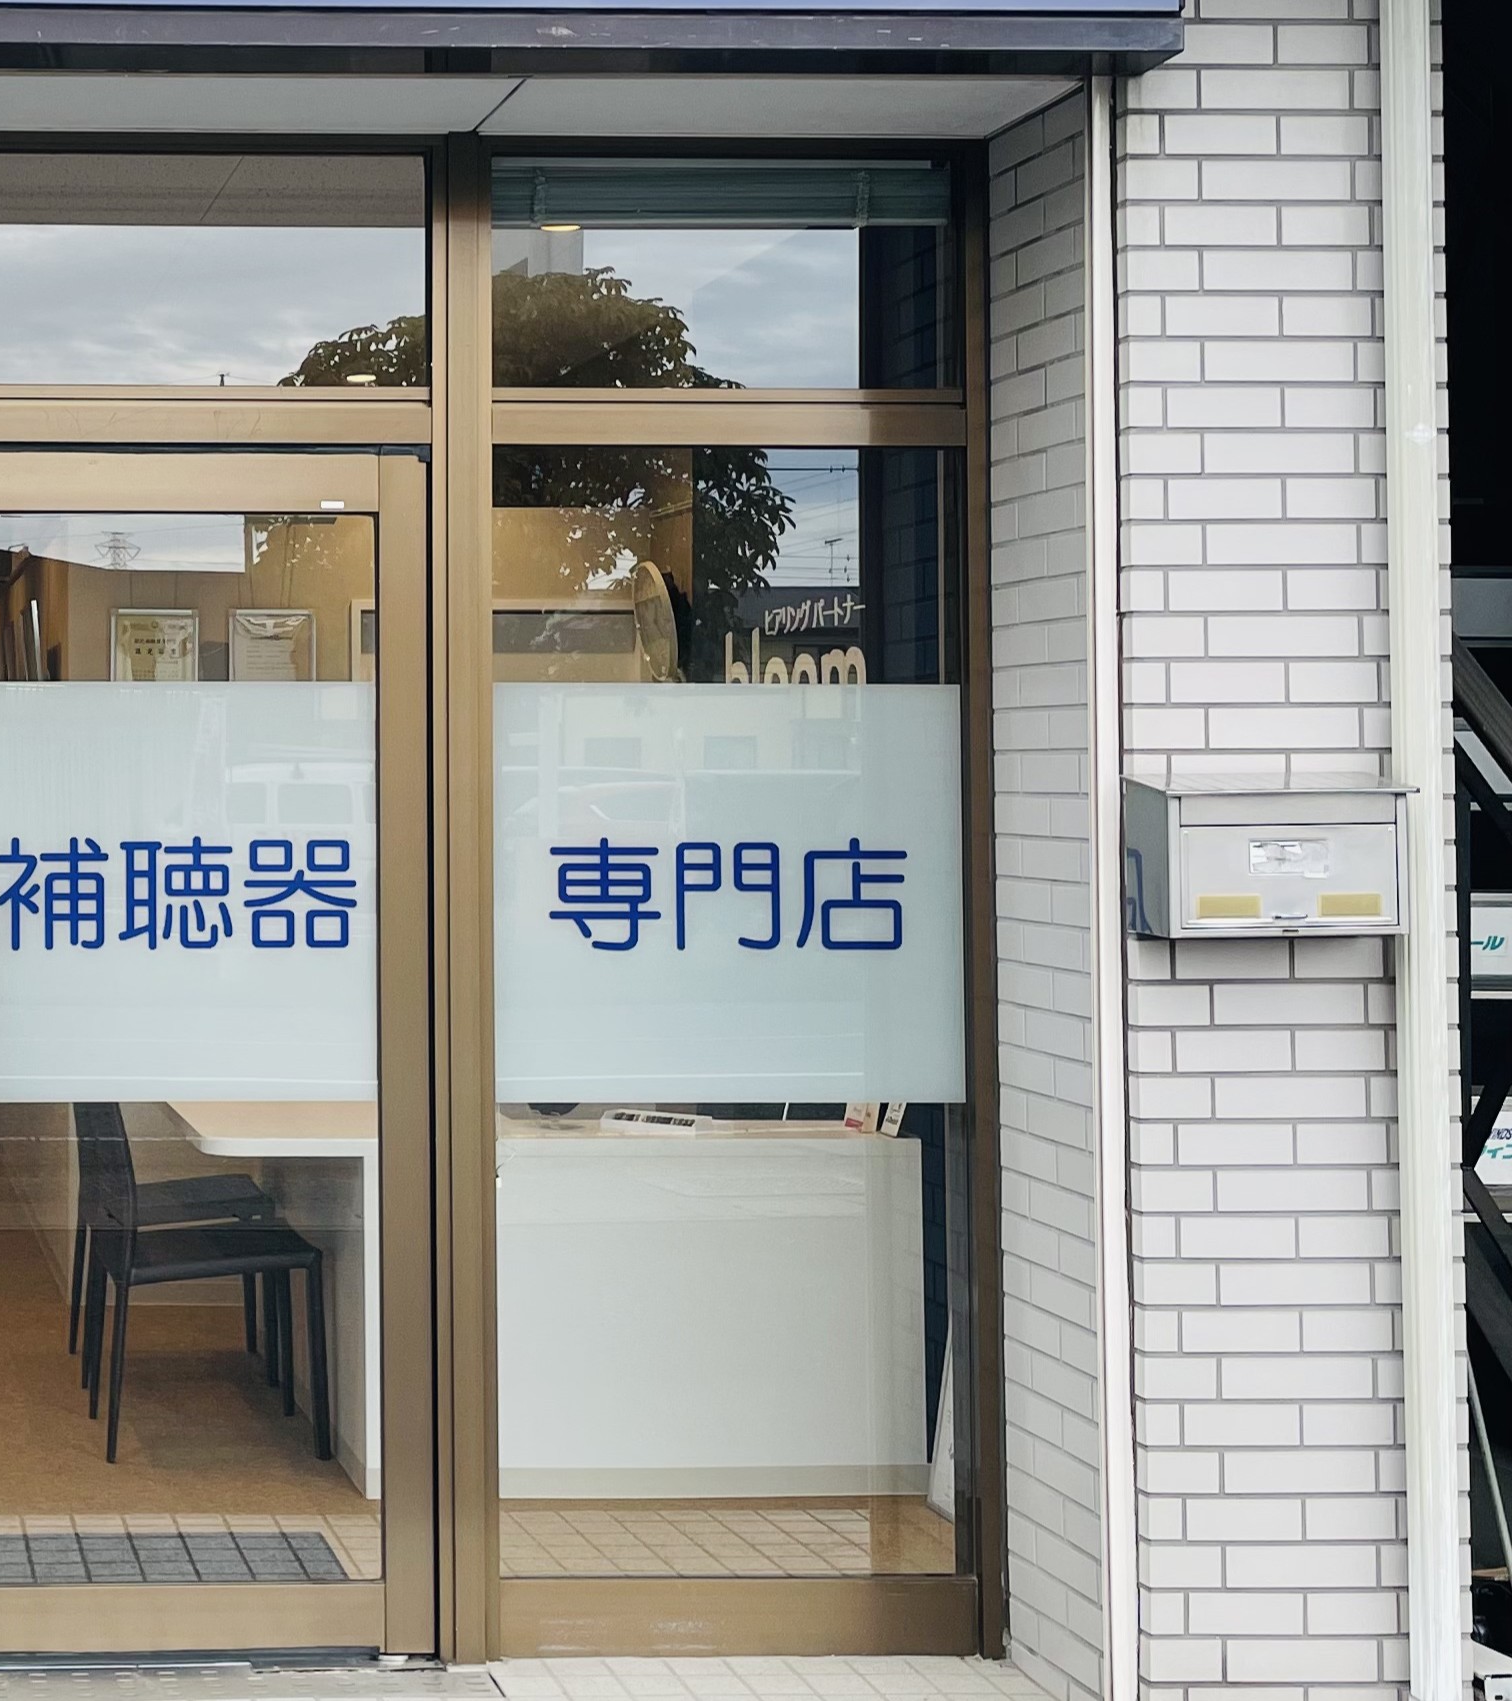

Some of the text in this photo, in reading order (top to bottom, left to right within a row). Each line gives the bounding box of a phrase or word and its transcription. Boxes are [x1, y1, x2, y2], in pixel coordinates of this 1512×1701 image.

[765, 594, 866, 635] ヒアリングパートナー
[549, 837, 909, 951] 専門店
